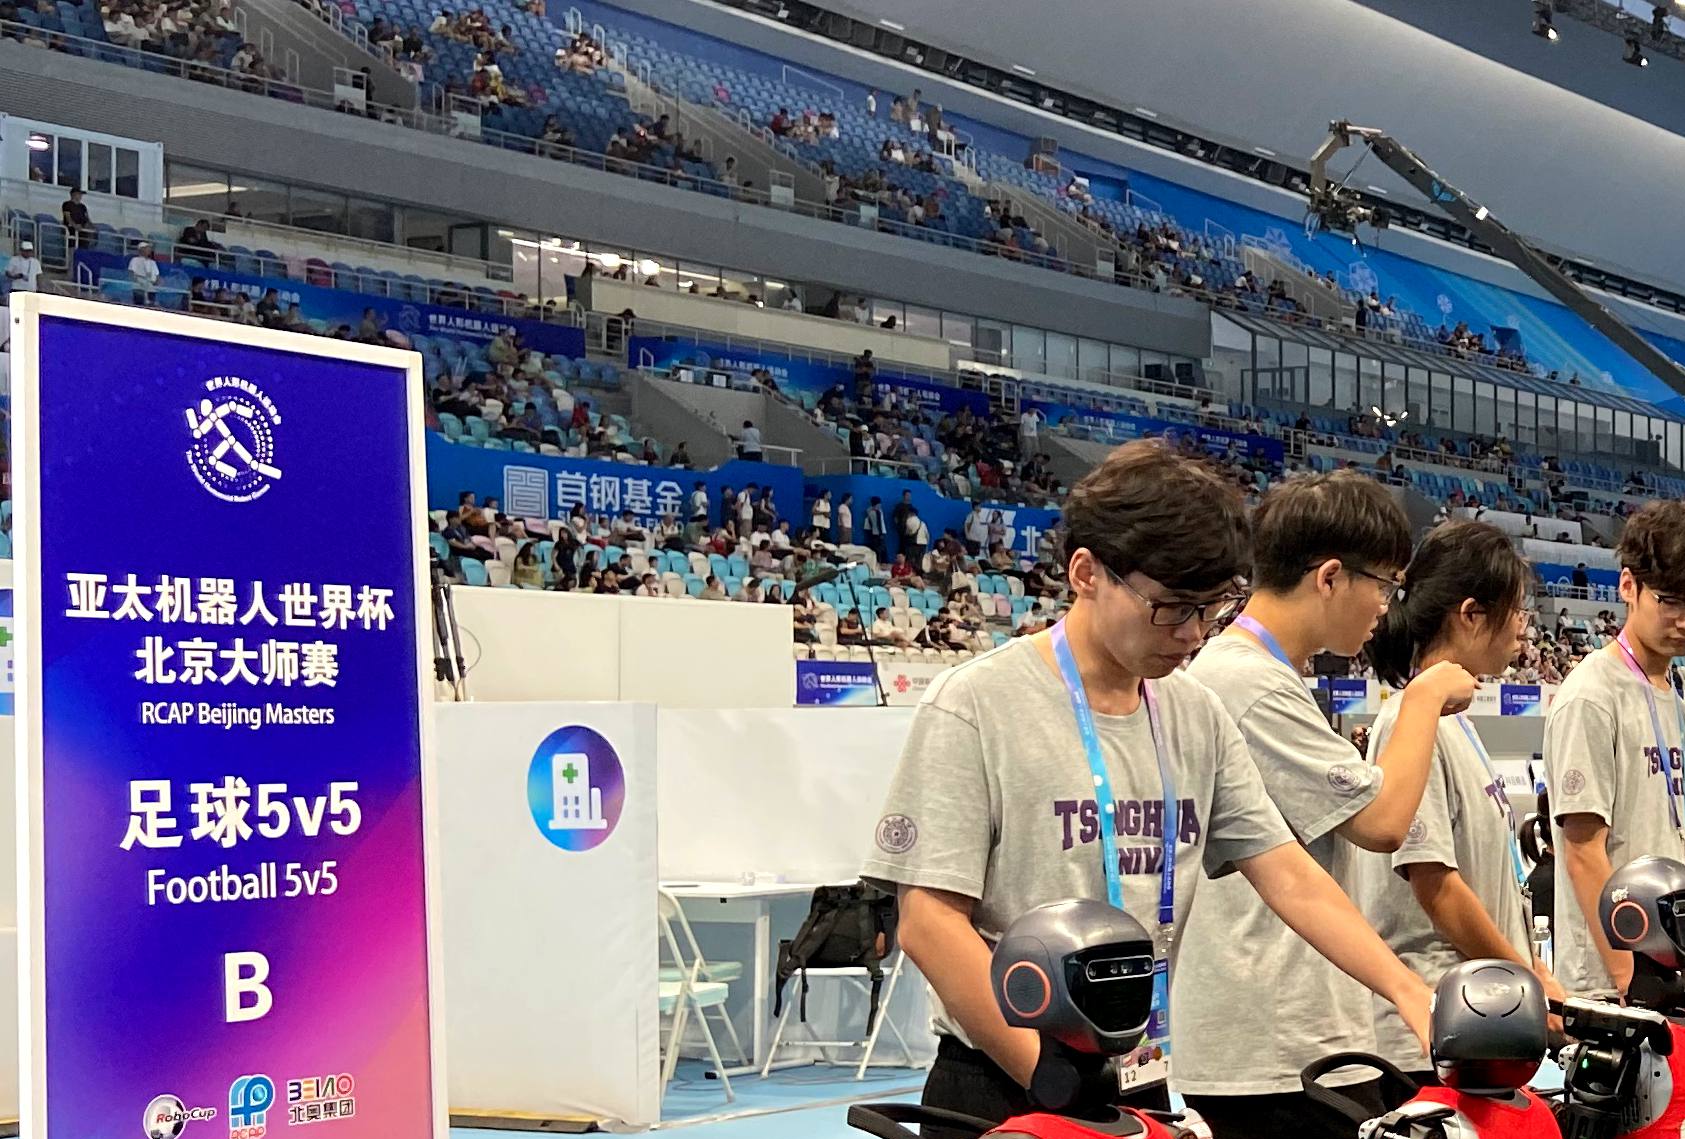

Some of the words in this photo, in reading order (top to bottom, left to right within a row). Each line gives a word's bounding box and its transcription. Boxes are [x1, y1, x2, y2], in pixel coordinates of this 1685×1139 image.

[556, 470, 684, 518] 首钢基金
[65, 572, 395, 631] 亚太机器人世界杯
[134, 636, 339, 688] 北京大师赛
[142, 702, 194, 725] RCAP
[199, 703, 261, 730] Beijing
[266, 704, 335, 725] Masters
[119, 776, 362, 851] 足球5v5
[1054, 798, 1201, 851] TSNGHA
[148, 862, 277, 906] Football
[284, 860, 338, 897] 5v5
[224, 951, 273, 1023] B
[156, 1107, 216, 1124] RoboCup
[289, 1099, 354, 1124] 北奥集团
